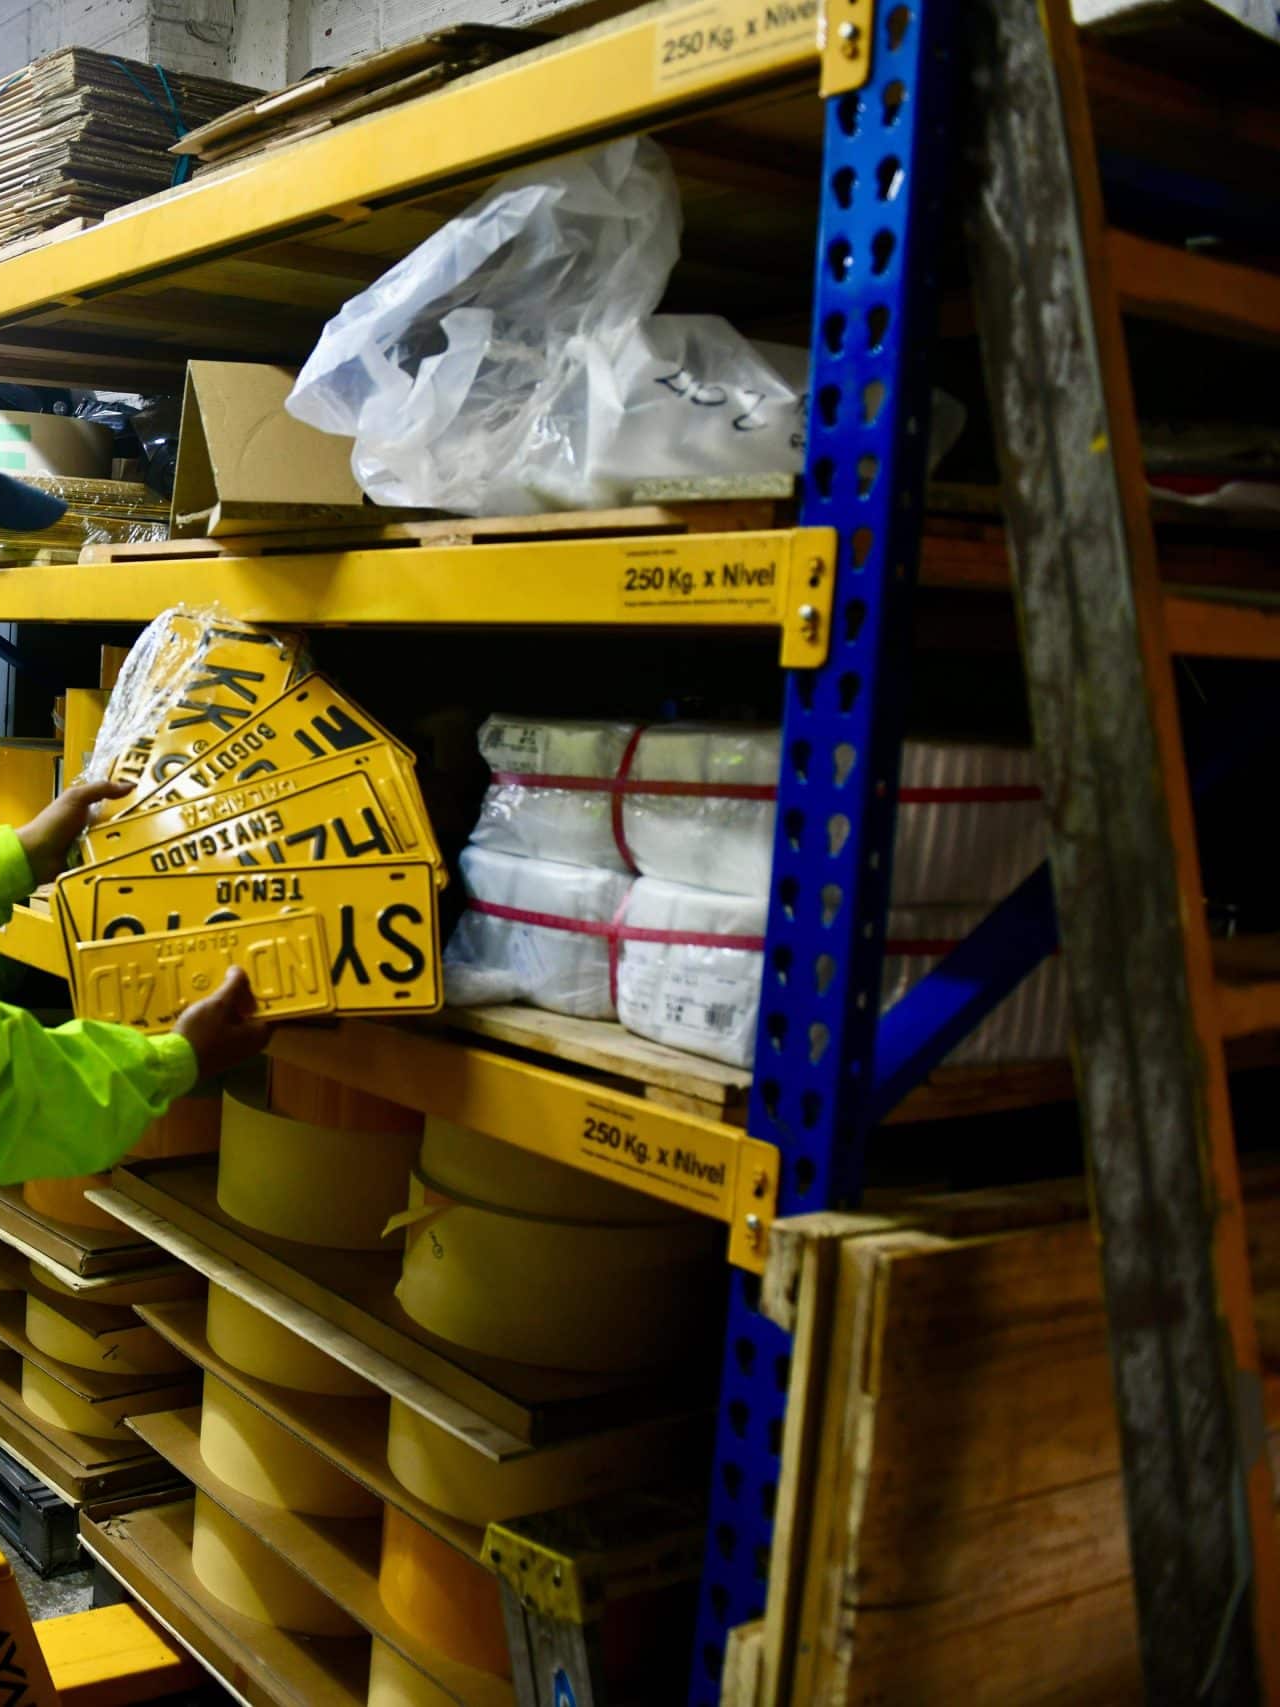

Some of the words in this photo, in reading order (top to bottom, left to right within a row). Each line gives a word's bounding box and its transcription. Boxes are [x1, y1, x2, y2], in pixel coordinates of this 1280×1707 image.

[662, 30, 704, 64] 250
[746, 19, 757, 37] x
[624, 566, 665, 591] 250
[704, 569, 716, 587] x
[722, 562, 777, 588] Nivel
[189, 722, 277, 788] BOGOTA
[150, 811, 285, 873] ENVIGADO
[216, 878, 303, 904] TENJO
[583, 1117, 622, 1149] 250
[657, 1147, 669, 1166] x
[673, 1148, 726, 1185] Nivel
